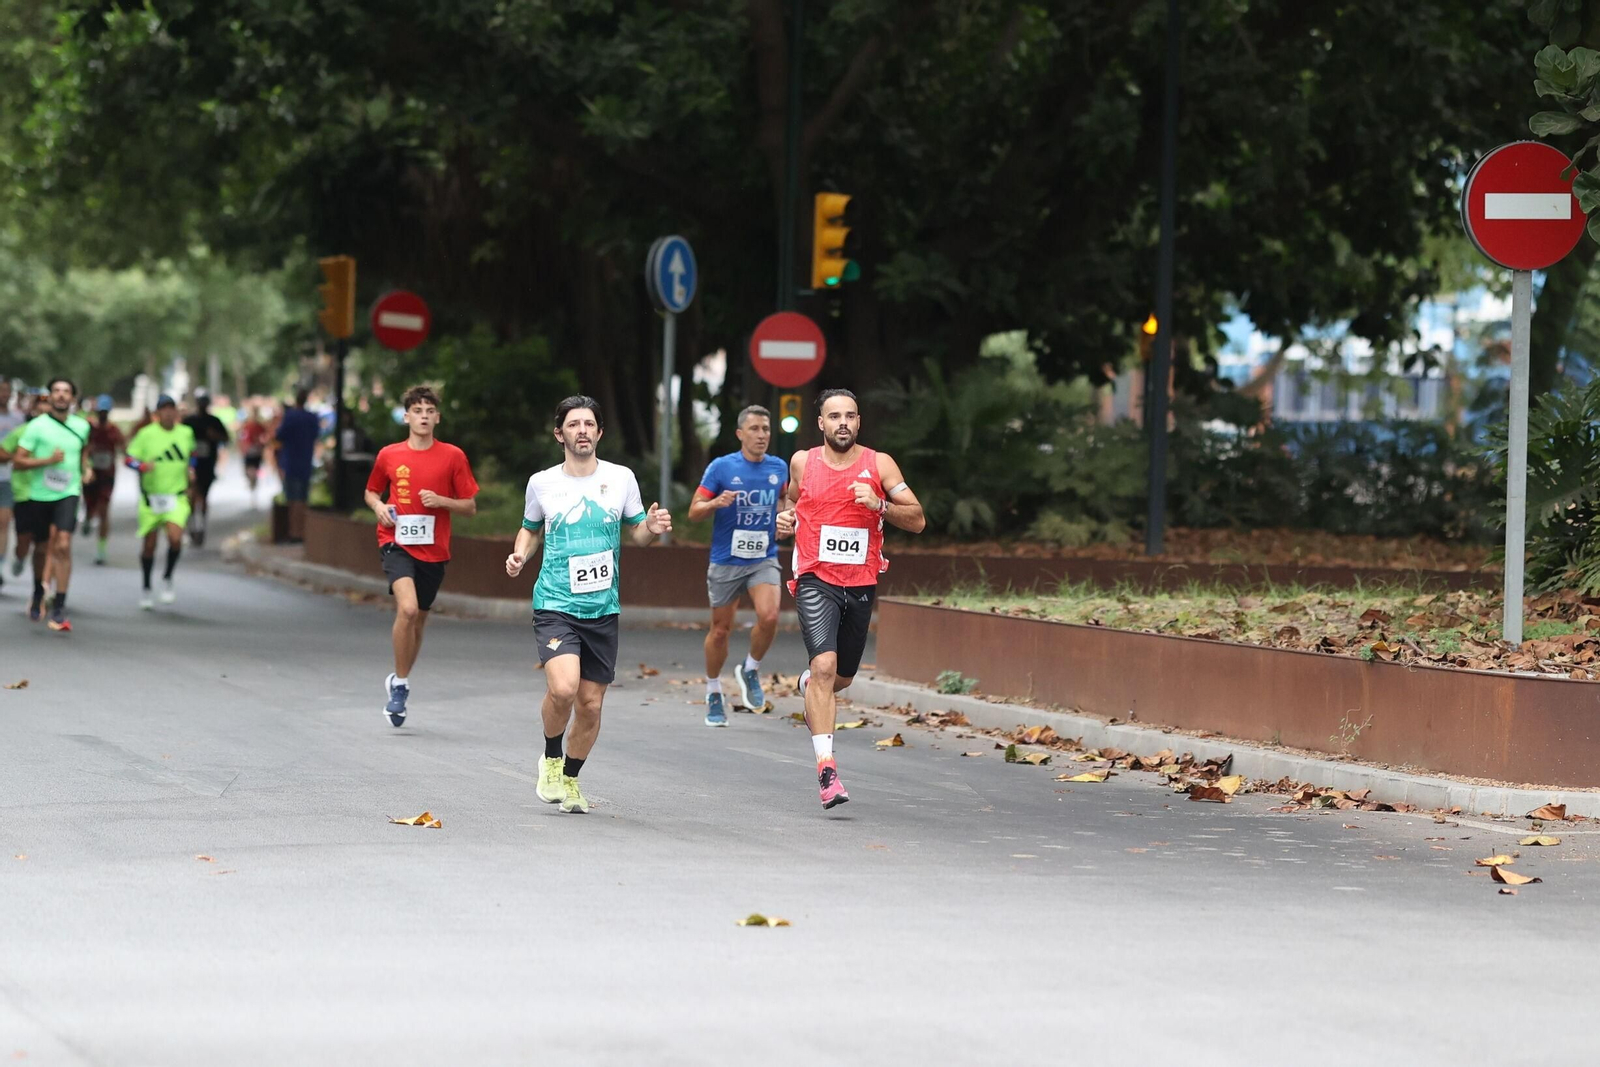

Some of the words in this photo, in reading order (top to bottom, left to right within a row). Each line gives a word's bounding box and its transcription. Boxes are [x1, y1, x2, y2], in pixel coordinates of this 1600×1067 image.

[736, 489, 776, 507] RCM
[736, 512, 772, 526] 1873
[400, 525, 427, 536] 361
[737, 540, 764, 551] 266
[826, 538, 860, 553] 904
[576, 564, 609, 582] 218
